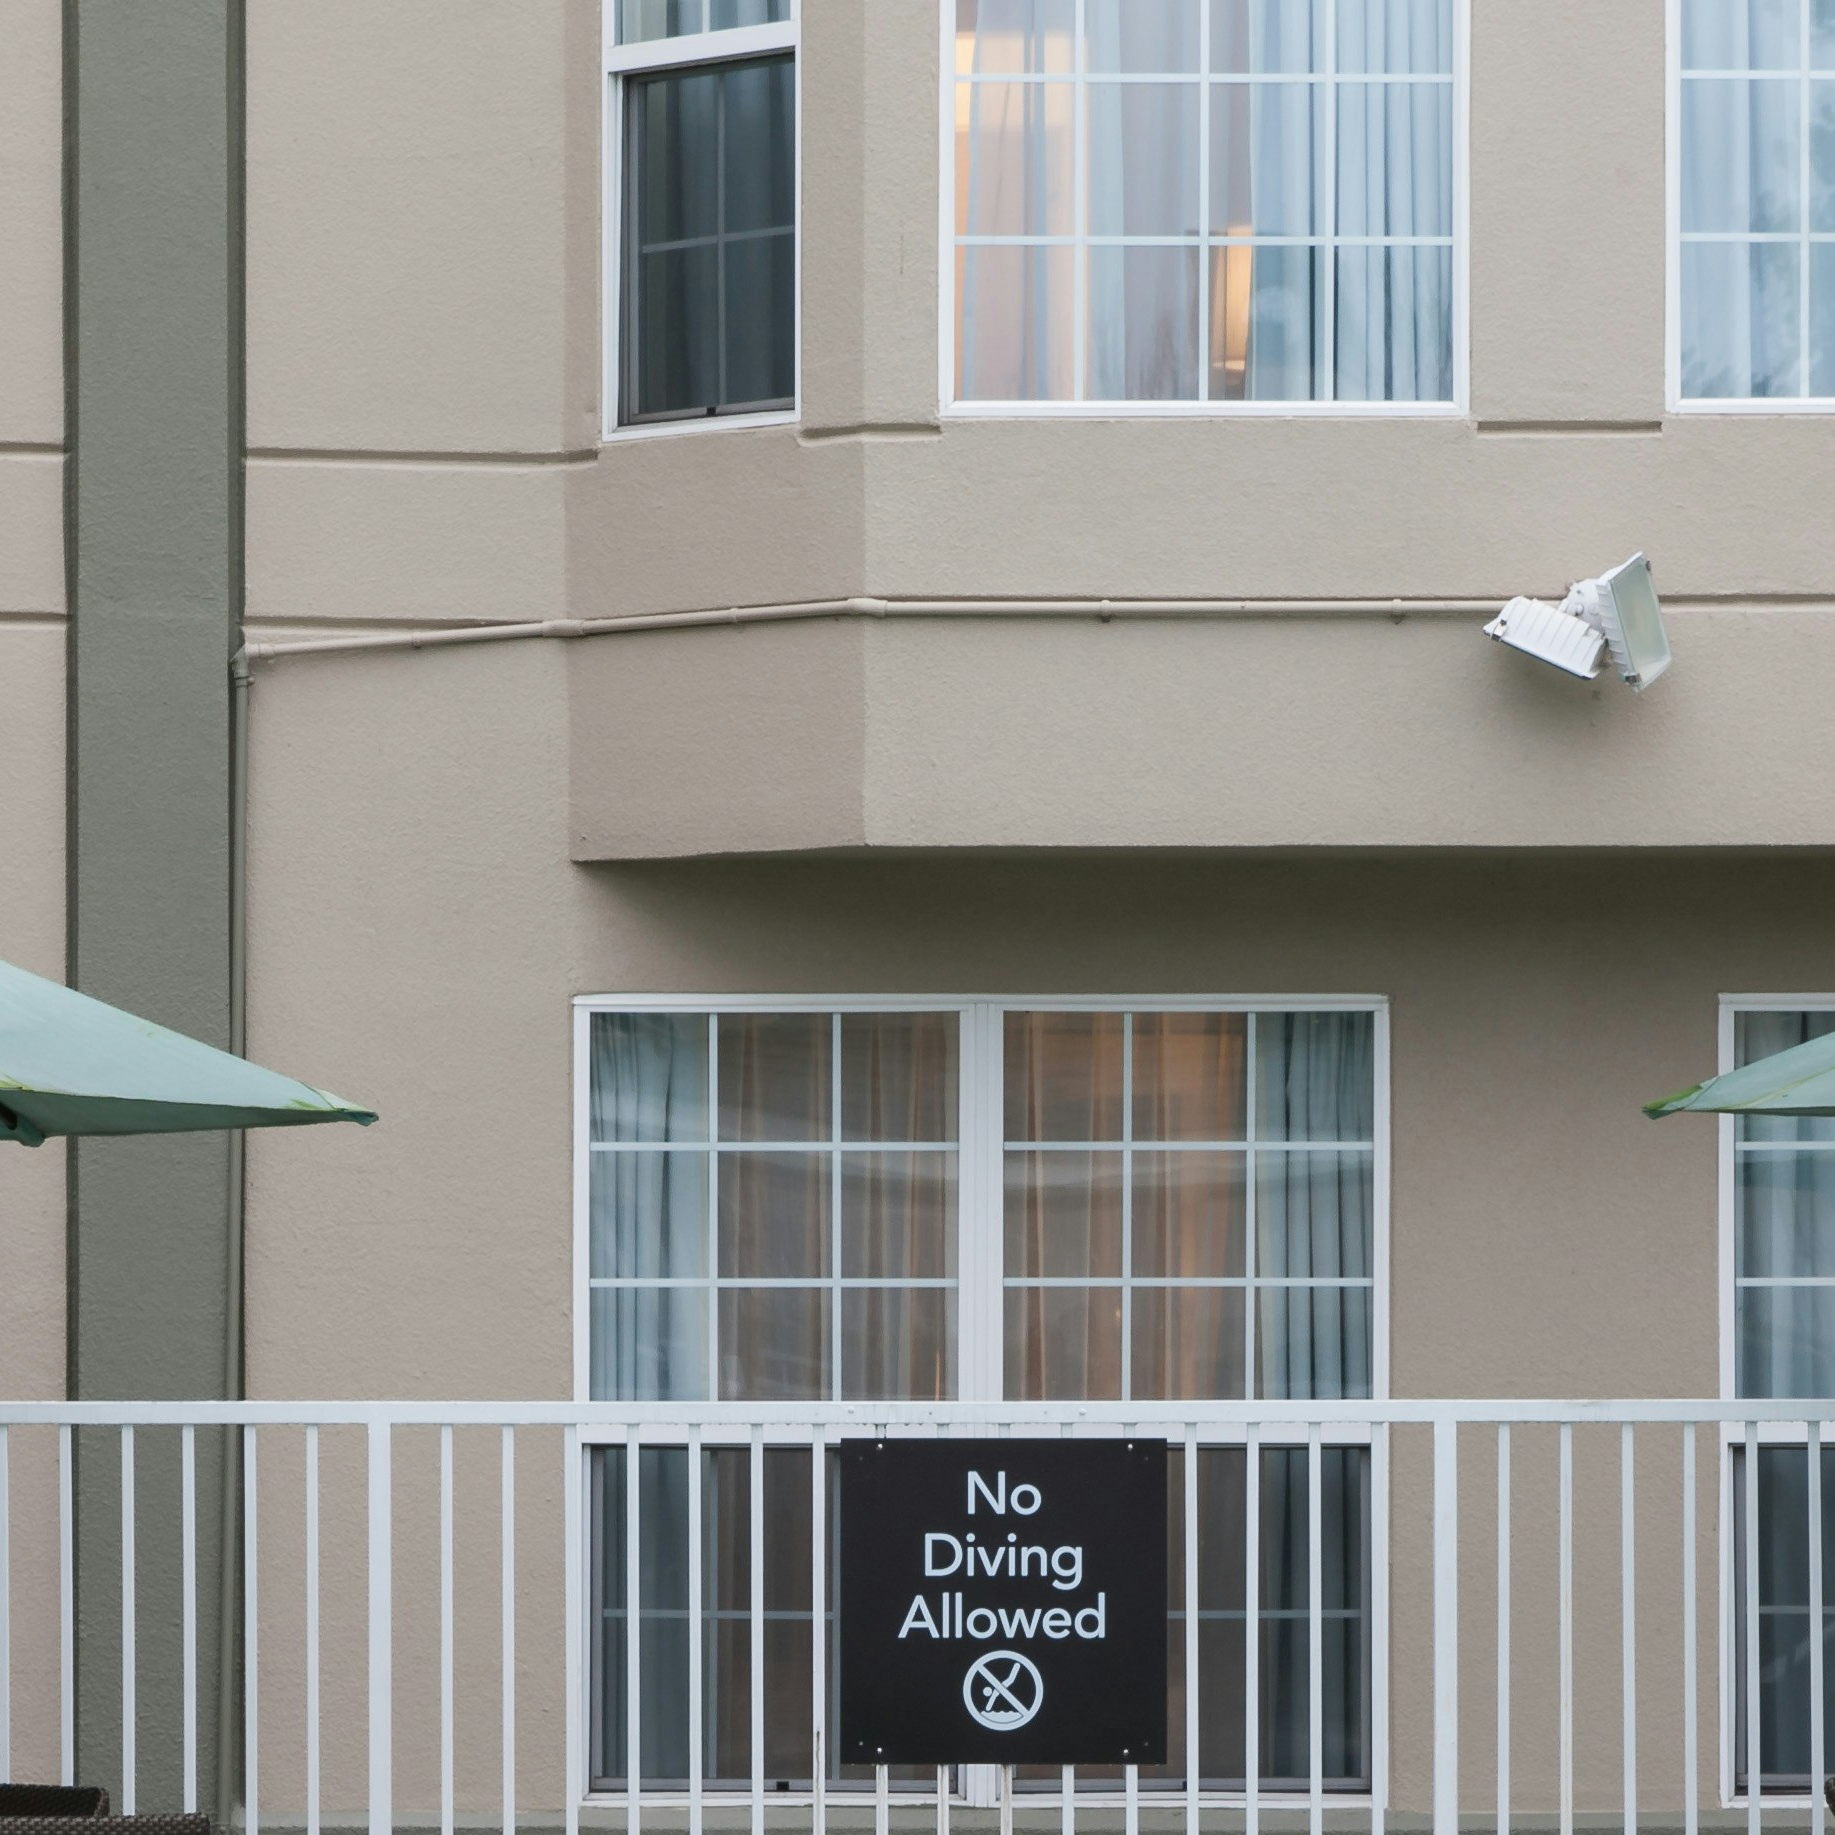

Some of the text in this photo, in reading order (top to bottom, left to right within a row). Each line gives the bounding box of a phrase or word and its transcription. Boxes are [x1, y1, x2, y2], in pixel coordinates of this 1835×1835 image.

[967, 1470, 1042, 1516] No
[924, 1532, 1083, 1591] Diving
[897, 1591, 1106, 1640] Allowed
